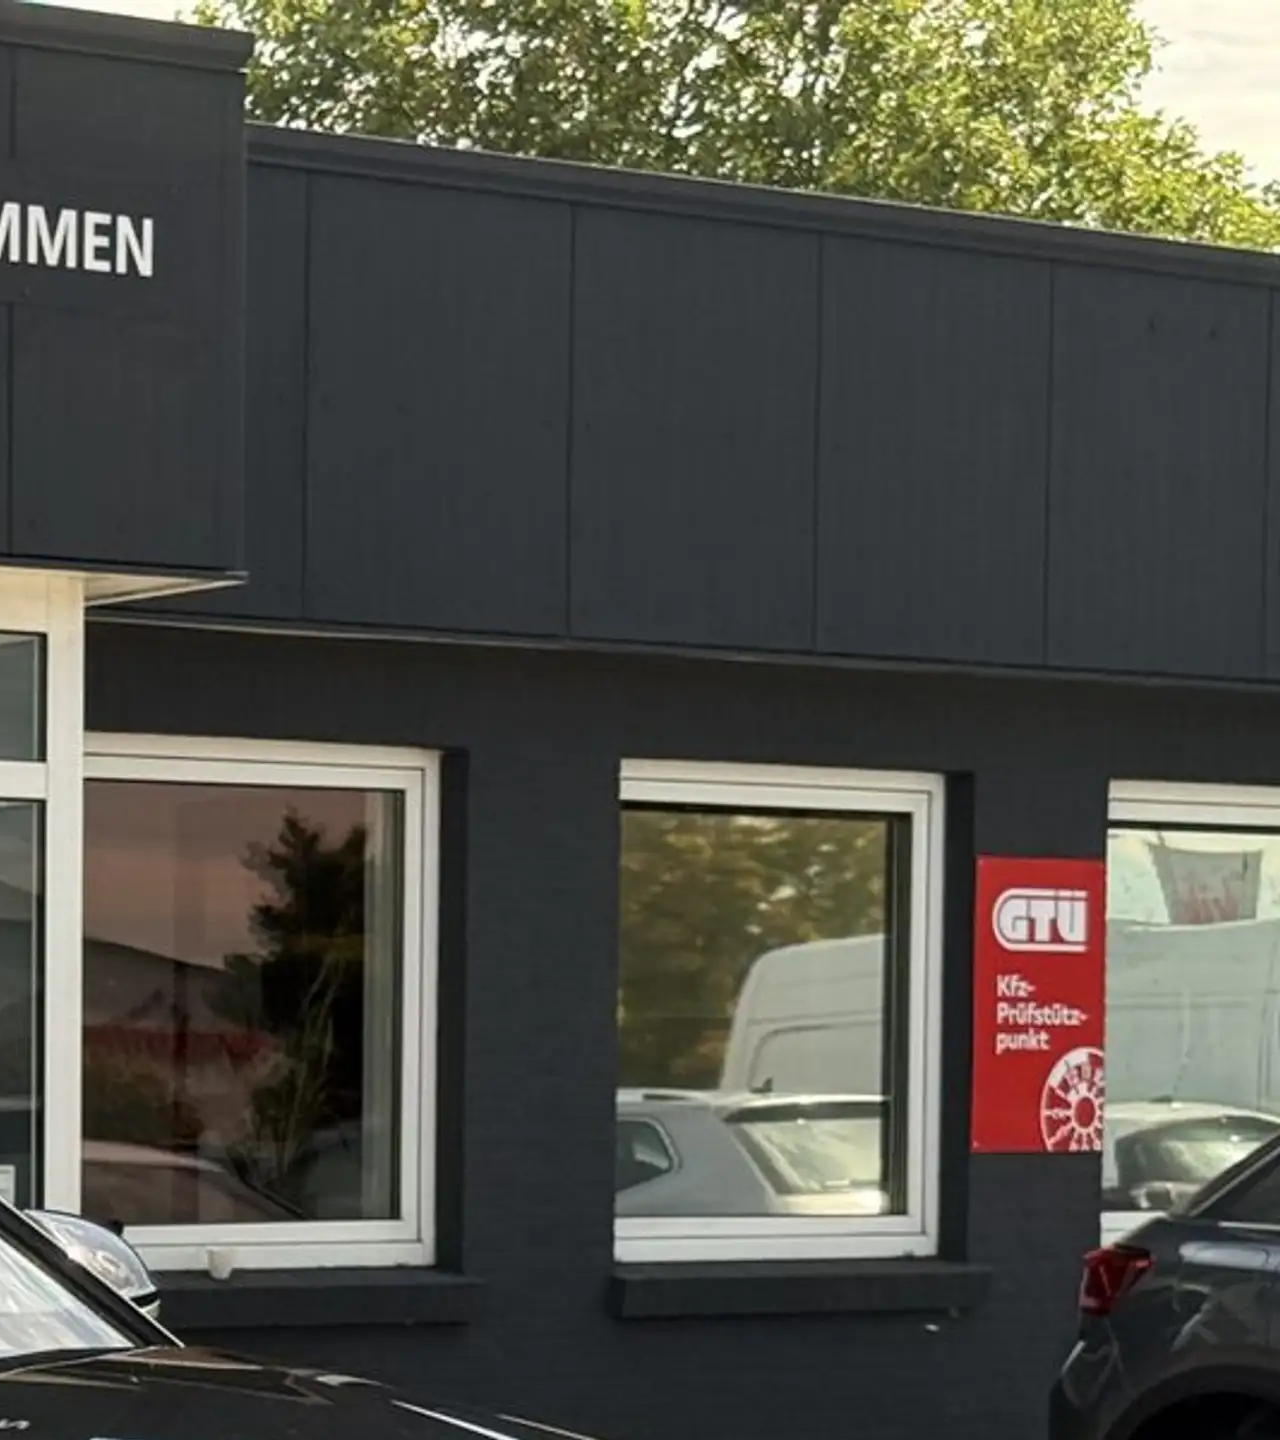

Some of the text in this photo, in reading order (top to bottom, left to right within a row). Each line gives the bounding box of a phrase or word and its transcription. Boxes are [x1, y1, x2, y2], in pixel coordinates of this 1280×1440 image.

[992, 887, 1089, 952] GTÜ
[995, 974, 1036, 998] Kfz-
[995, 1002, 1089, 1027] Prüfstütz-
[994, 1027, 1051, 1055] punkt
